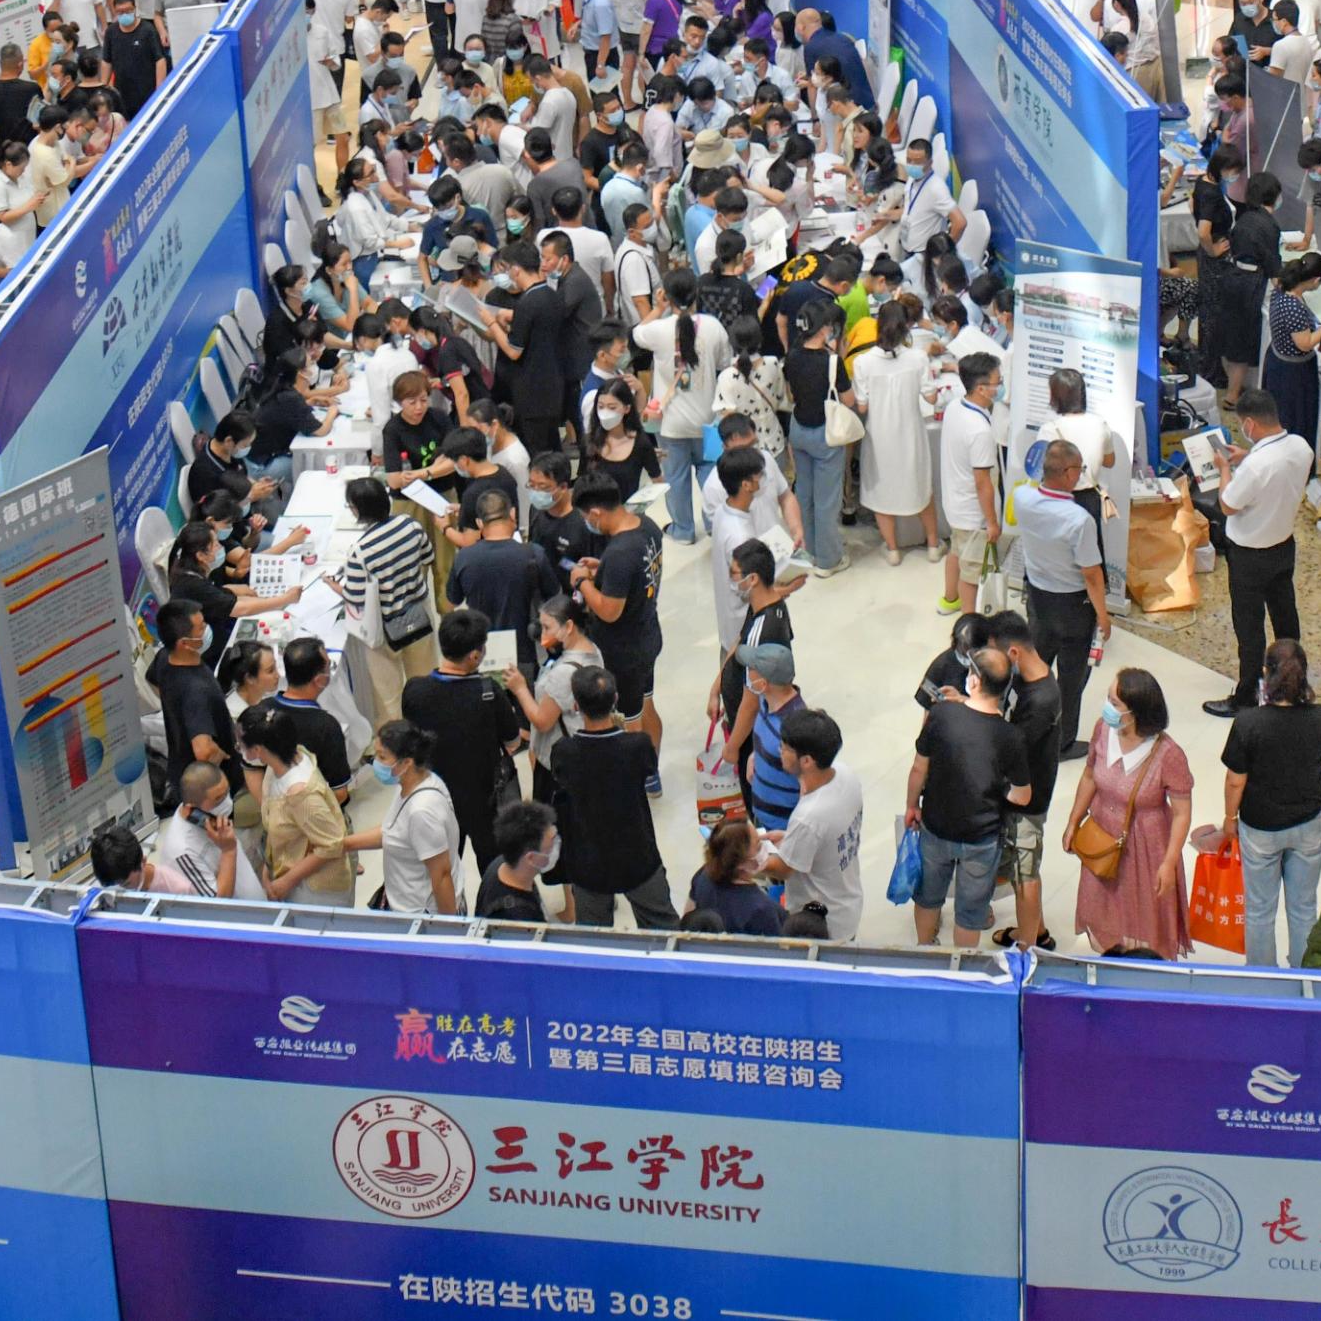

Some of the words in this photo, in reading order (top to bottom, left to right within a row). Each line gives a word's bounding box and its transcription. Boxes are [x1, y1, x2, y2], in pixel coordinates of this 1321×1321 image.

[392, 1007, 448, 1065] 赢
[445, 1035, 518, 1066] 在志愿
[546, 1020, 843, 1064] 2022年全国高校在陕招生
[548, 1047, 844, 1092] 暨第三届志愿填报咨询会
[484, 1125, 767, 1192] 三江学院
[344, 1160, 402, 1211] SANJIANG
[411, 1166, 467, 1213] UNIVERSITY
[394, 1185, 418, 1194] 1992
[487, 1186, 612, 1214] SANJIANG
[618, 1196, 762, 1225] UNIVERSITY
[1158, 1265, 1186, 1278] 1999
[398, 1272, 597, 1317] 在陕招生代码
[609, 1289, 694, 1321] 3038
